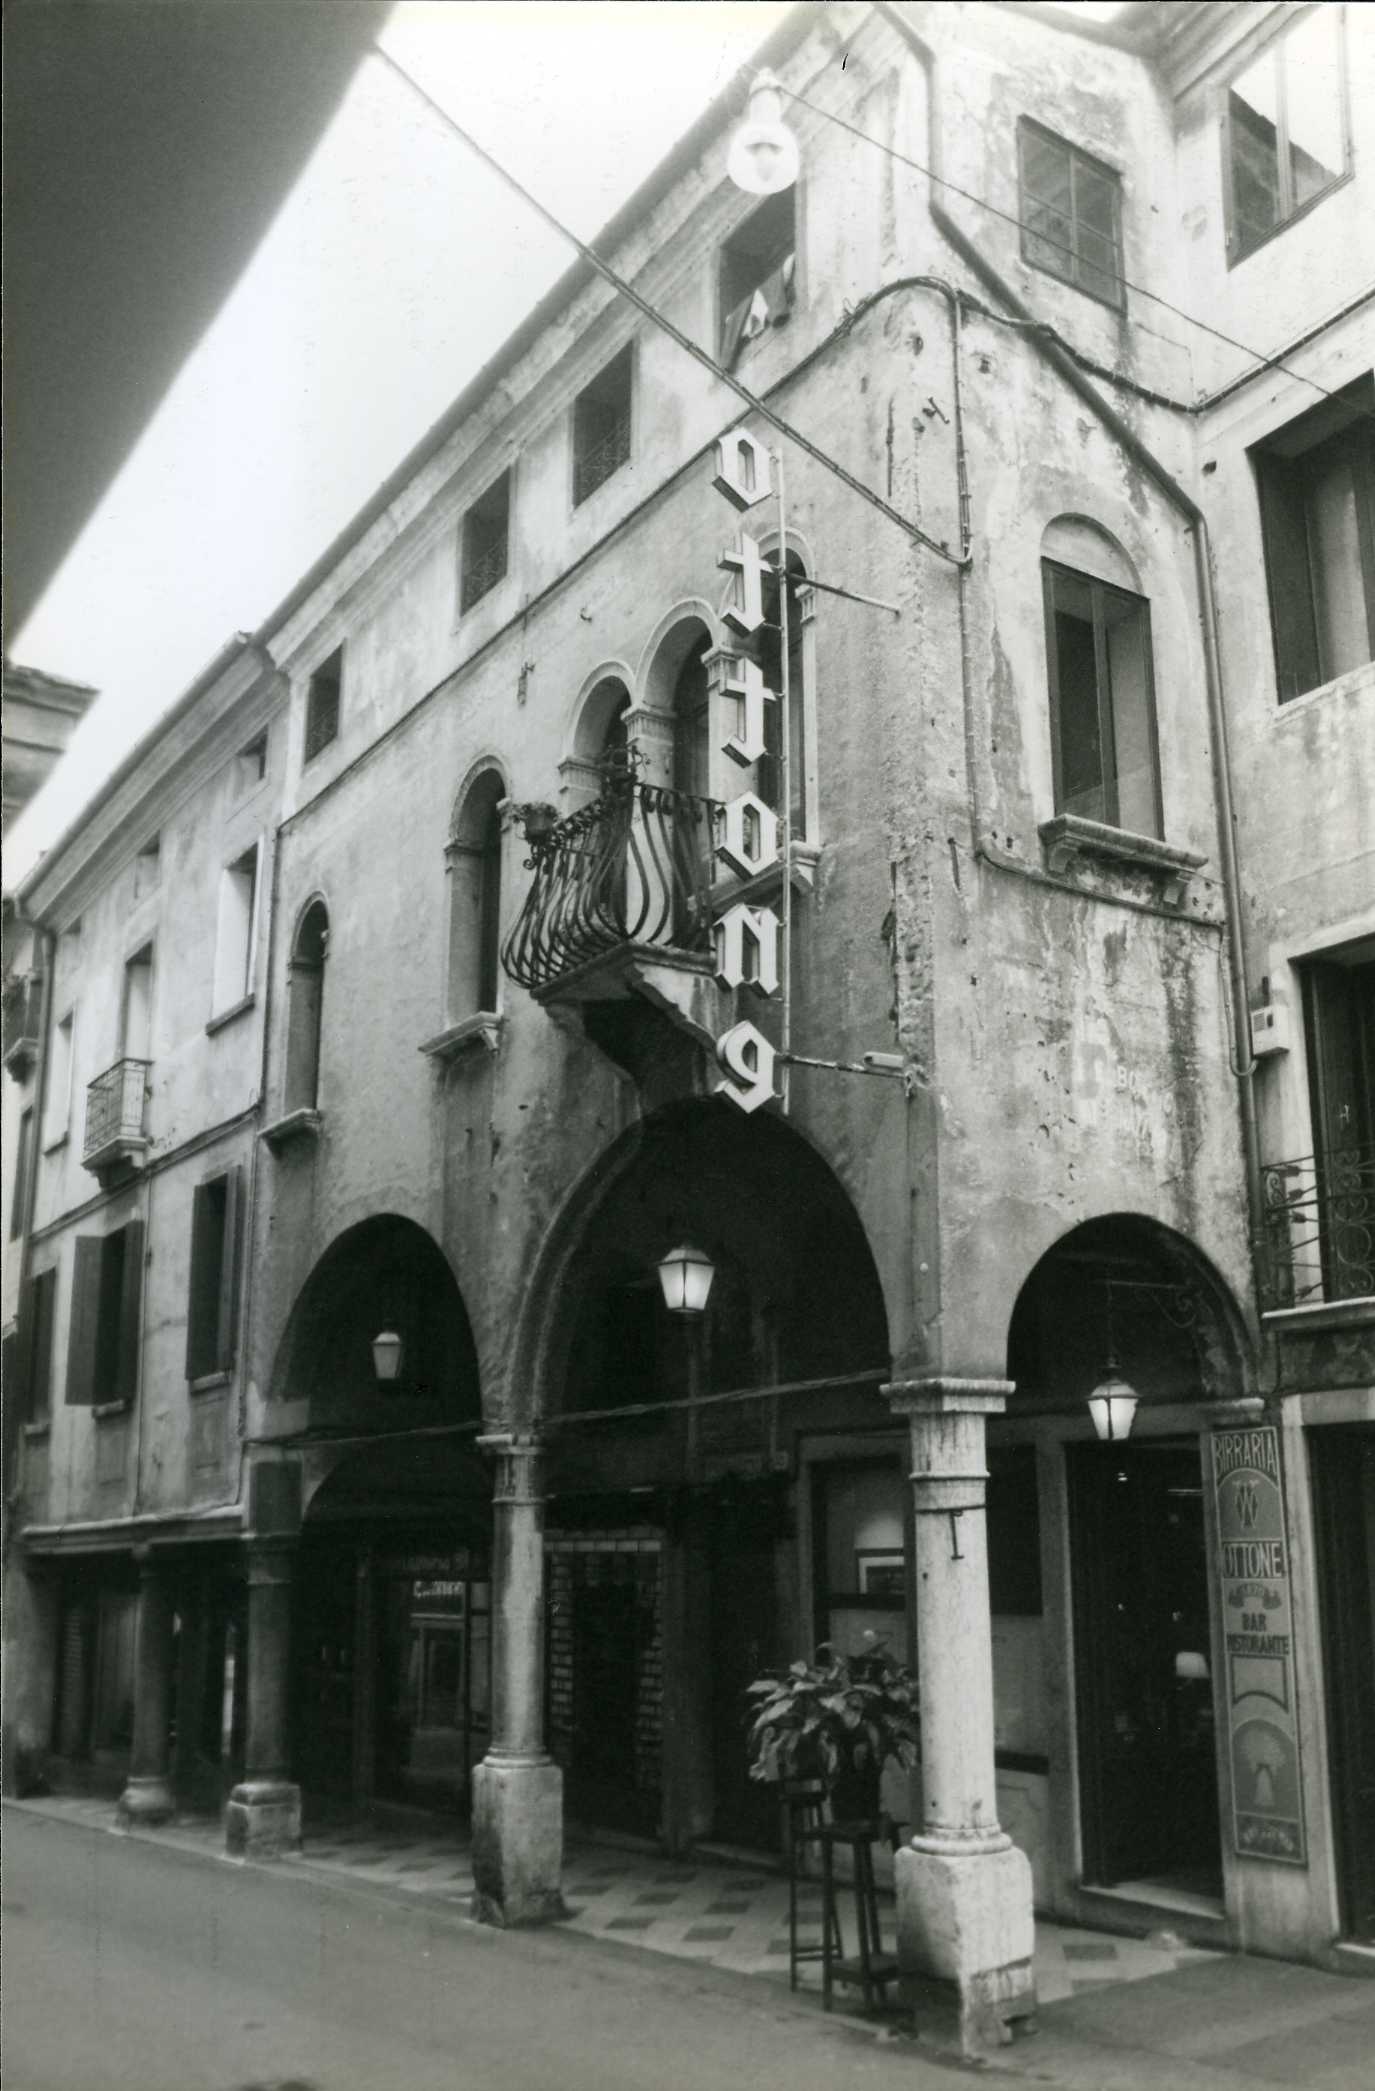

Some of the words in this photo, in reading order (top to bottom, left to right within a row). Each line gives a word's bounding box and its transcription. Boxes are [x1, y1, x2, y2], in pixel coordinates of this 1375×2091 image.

[1215, 1432, 1277, 1478] BIRRARIA
[1223, 1542, 1282, 1578] OTTONE
[1242, 1612, 1266, 1632] BAR
